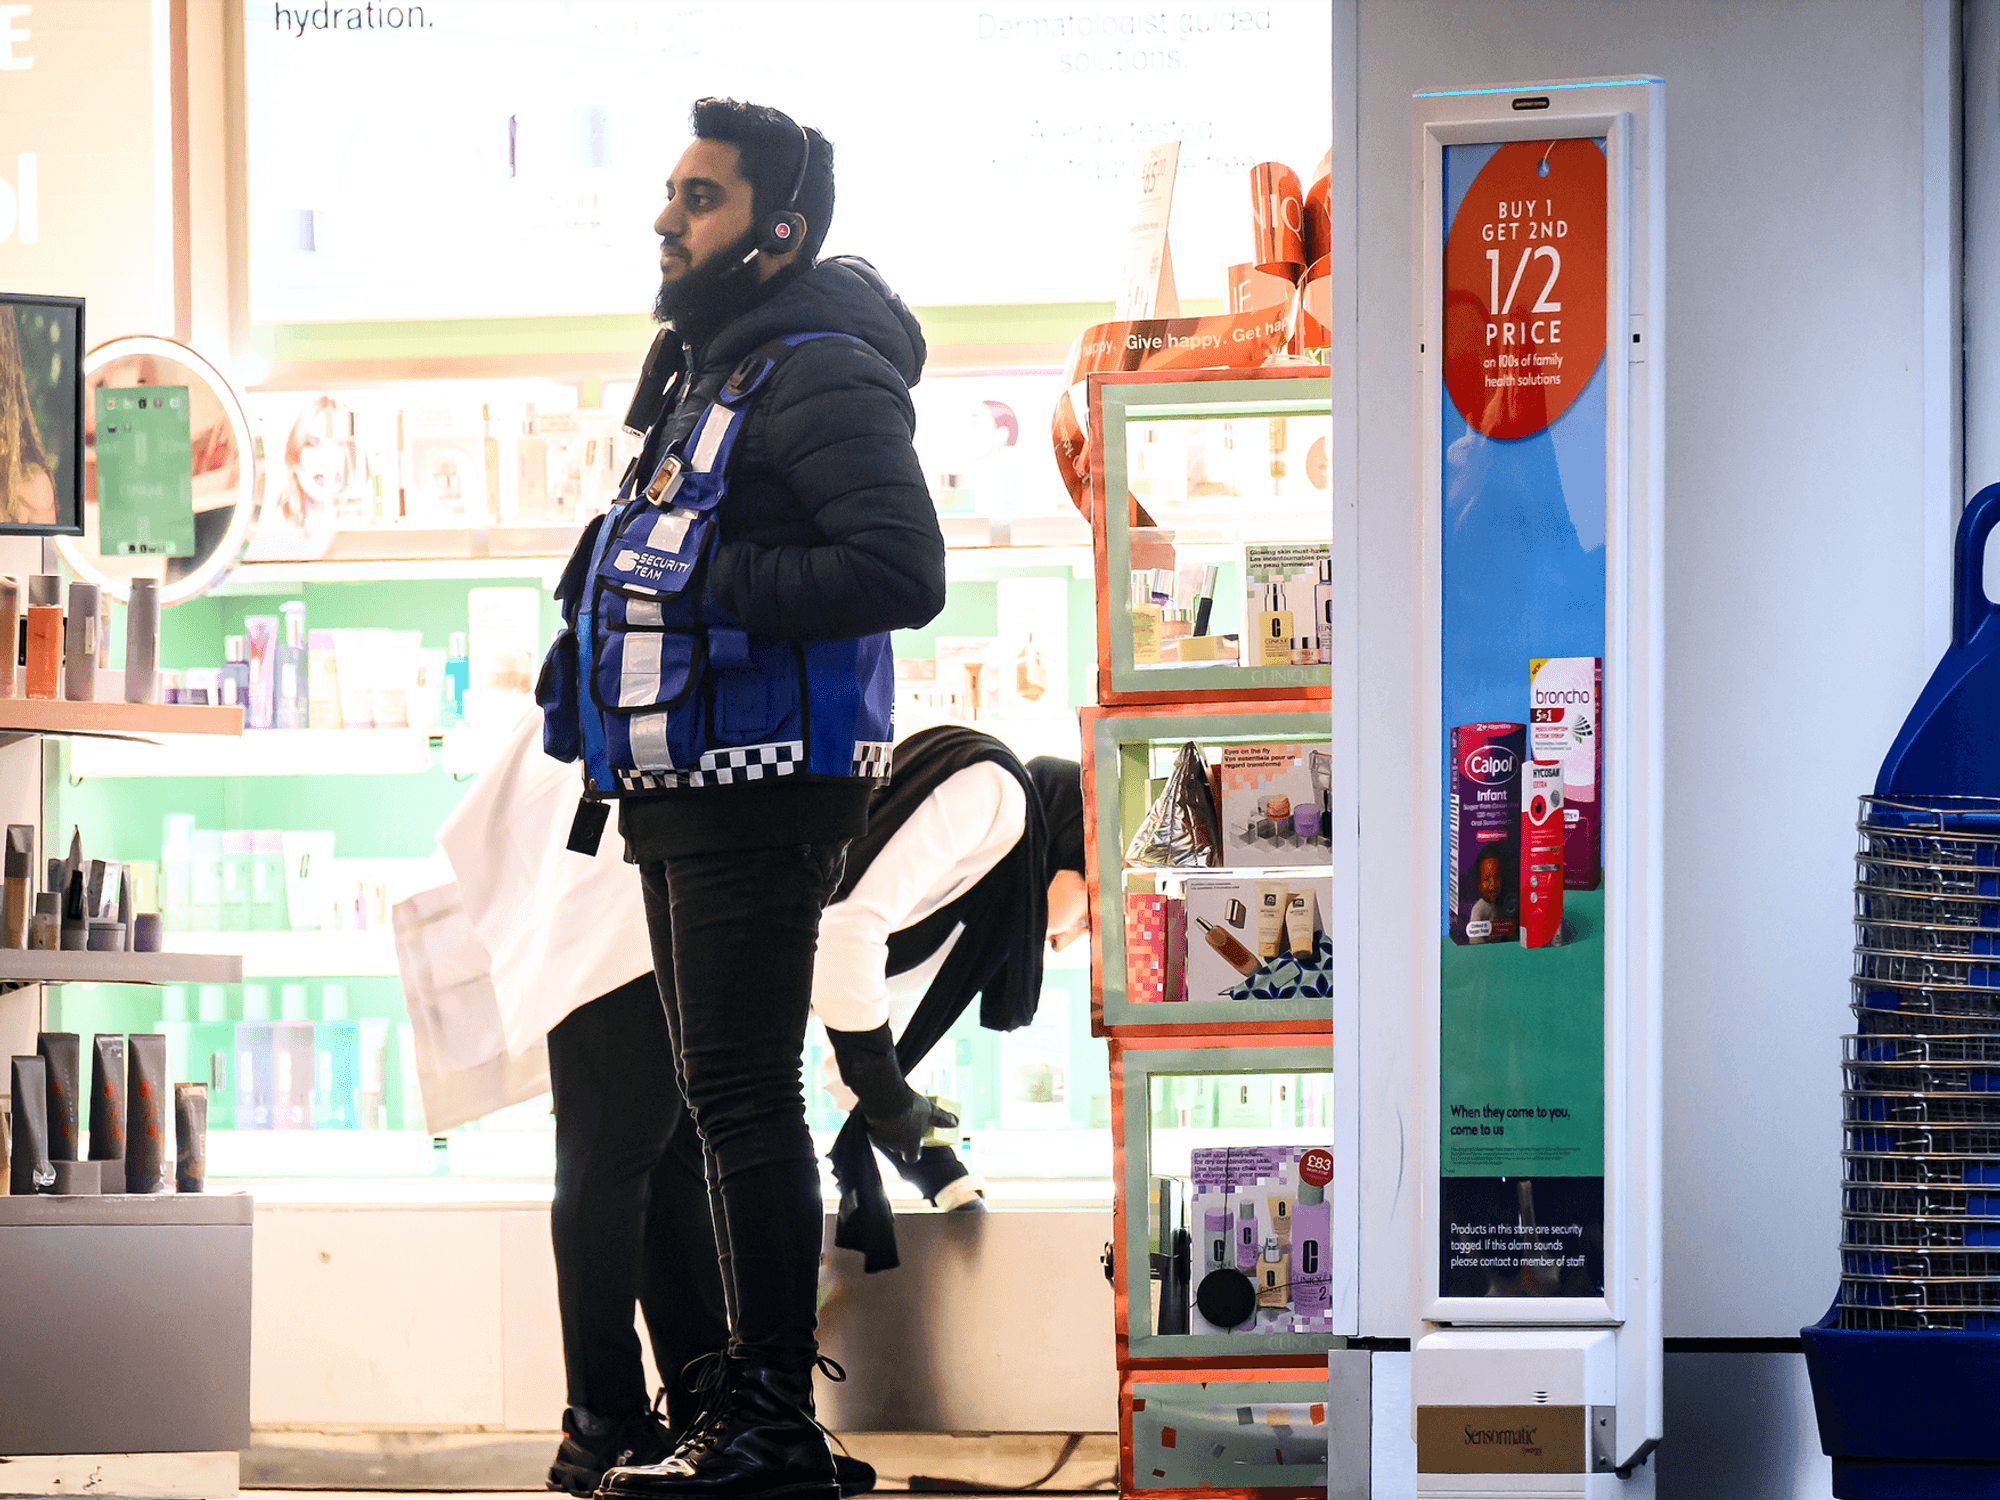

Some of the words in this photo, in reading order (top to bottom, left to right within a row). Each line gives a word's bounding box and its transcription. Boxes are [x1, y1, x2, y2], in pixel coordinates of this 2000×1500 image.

[275, 0, 433, 38] hydration.
[978, 10, 1168, 44] Dermatologist
[1178, 5, 1271, 42] guided
[1058, 47, 1188, 74] solutions.
[1498, 200, 1537, 219] BUY
[1546, 199, 1552, 217] 1
[1482, 222, 1519, 242] GET
[1529, 220, 1568, 240] 2ND
[1485, 245, 1562, 316] 1/2
[1126, 334, 1163, 350] Give
[1167, 333, 1228, 350] happy.
[1232, 325, 1262, 342] Get
[1485, 320, 1562, 347] PRICE
[1483, 358, 1496, 369] on
[1497, 354, 1519, 368] 100s
[1520, 353, 1531, 367] of
[1532, 352, 1564, 369] family
[1484, 375, 1516, 388] health
[1517, 373, 1561, 387] solutions
[638, 552, 691, 574] SECURITY
[633, 564, 664, 582] TEAM
[1535, 688, 1590, 705] broncho
[1471, 755, 1513, 777] Calpol
[1477, 789, 1508, 802] Infant
[1450, 1104, 1480, 1118] When
[1482, 1104, 1505, 1122] they
[1506, 1107, 1534, 1118] come
[1536, 1105, 1548, 1118] to
[1450, 1126, 1478, 1136] come
[1480, 1124, 1491, 1136] to
[1493, 1126, 1504, 1136] us
[1306, 1154, 1332, 1171] £83
[1450, 1222, 1487, 1235] Products
[1488, 1222, 1497, 1235] in
[1497, 1222, 1512, 1235] this
[1513, 1223, 1534, 1235] store
[1535, 1225, 1550, 1235] are
[1550, 1222, 1583, 1238] security
[1450, 1240, 1483, 1254] tagged.
[1484, 1239, 1492, 1251] If
[1492, 1239, 1507, 1251] this
[1507, 1239, 1532, 1251] alarm
[1533, 1239, 1563, 1251] sounds
[1450, 1256, 1478, 1269] please
[1480, 1256, 1511, 1267] contact
[1512, 1258, 1519, 1267] a
[1520, 1255, 1555, 1267] member
[1556, 1255, 1566, 1267] of
[1566, 1254, 1586, 1267] staff
[1318, 1286, 1327, 1302] 2
[1464, 1424, 1535, 1446] Sensormatic
